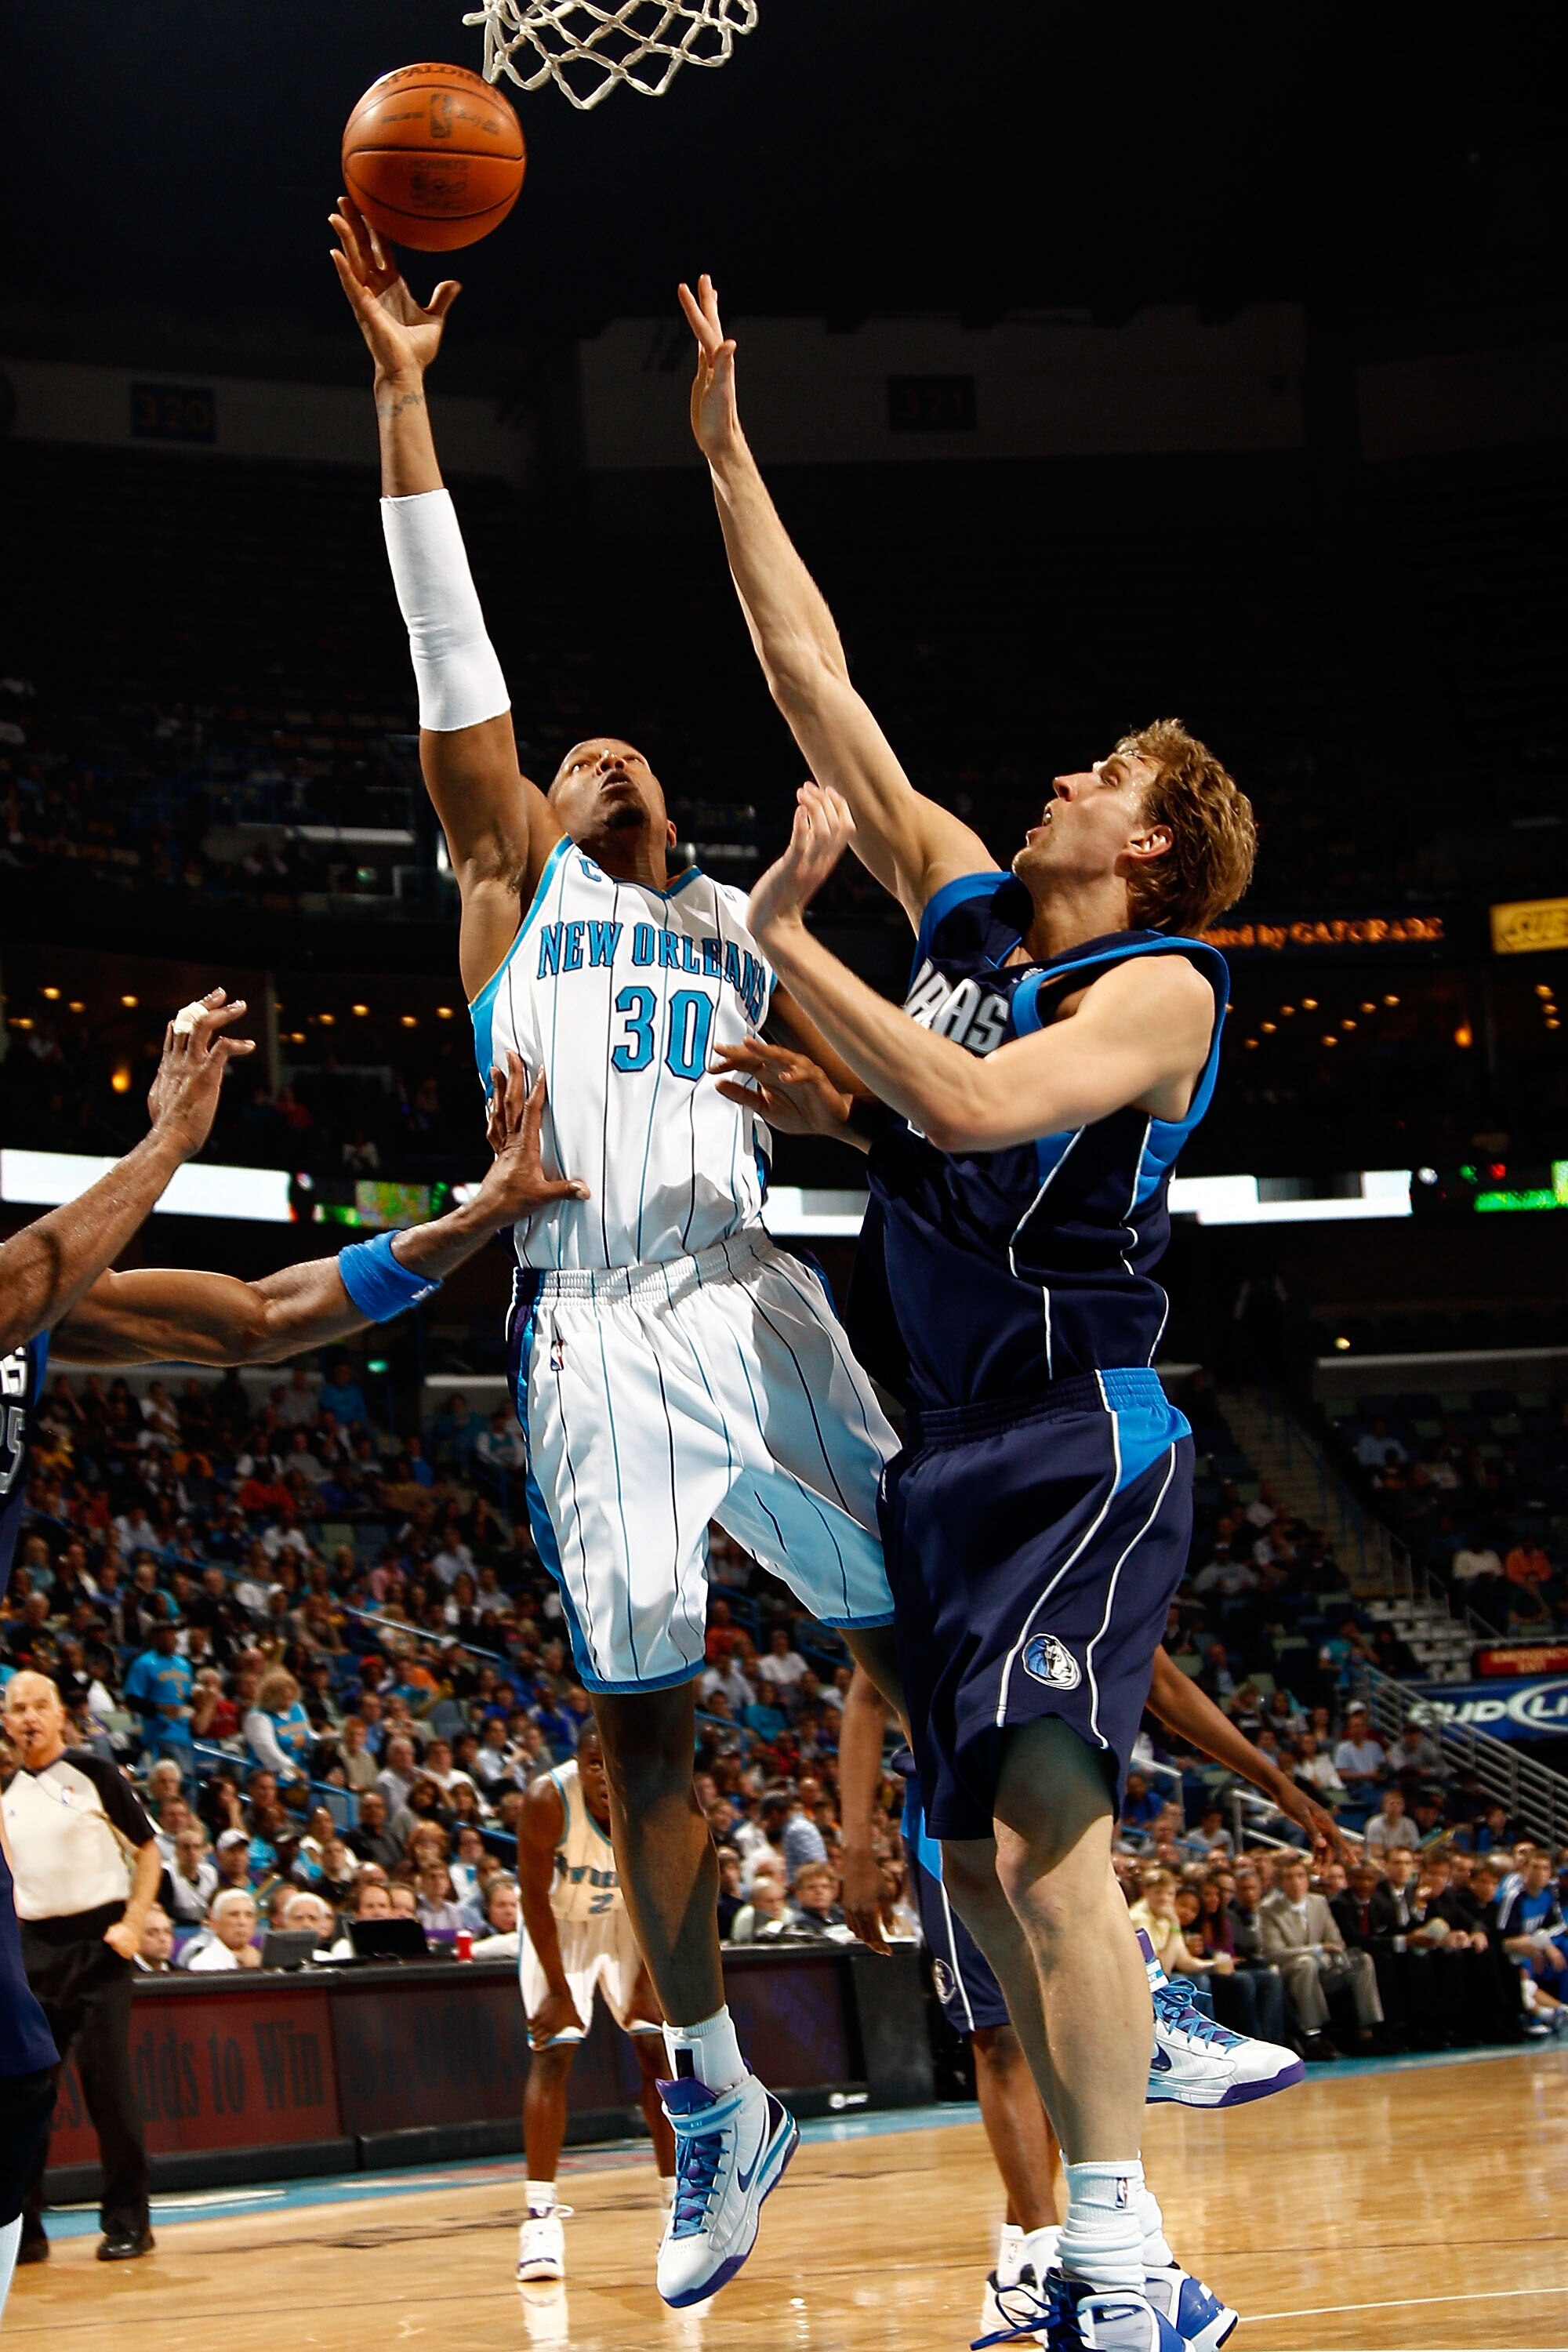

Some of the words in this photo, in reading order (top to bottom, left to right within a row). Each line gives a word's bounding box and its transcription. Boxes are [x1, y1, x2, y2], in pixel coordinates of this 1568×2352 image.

[136, 394, 212, 431] 320
[900, 387, 966, 418] 321
[536, 920, 623, 980] NEW
[631, 922, 767, 1025] ORLEANS
[611, 985, 715, 1083] 30
[1408, 1698, 1507, 1726] BUD
[206, 2025, 246, 2115] to
[252, 2017, 326, 2111] Win
